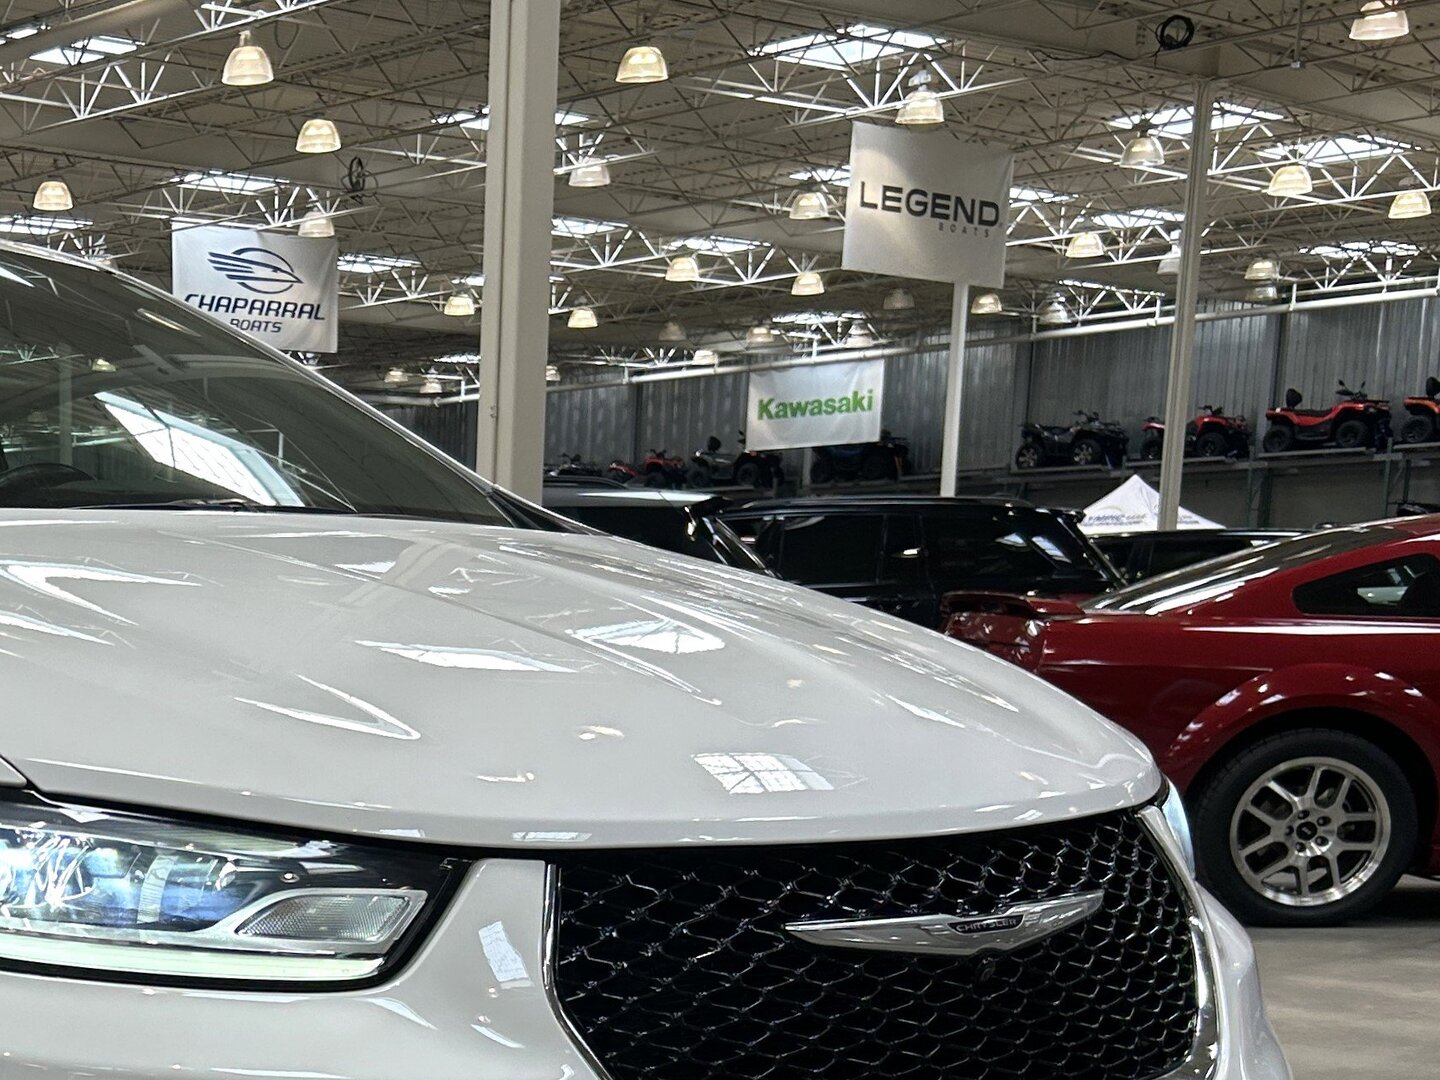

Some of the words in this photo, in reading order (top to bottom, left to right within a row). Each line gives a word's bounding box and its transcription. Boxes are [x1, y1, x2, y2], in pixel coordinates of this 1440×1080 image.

[859, 181, 1000, 227] LEGEND
[184, 293, 325, 320] CHAPARRAL
[229, 318, 283, 333] BOATS
[758, 388, 874, 420] Kawasaki
[955, 918, 1018, 932] CHRYSLER
